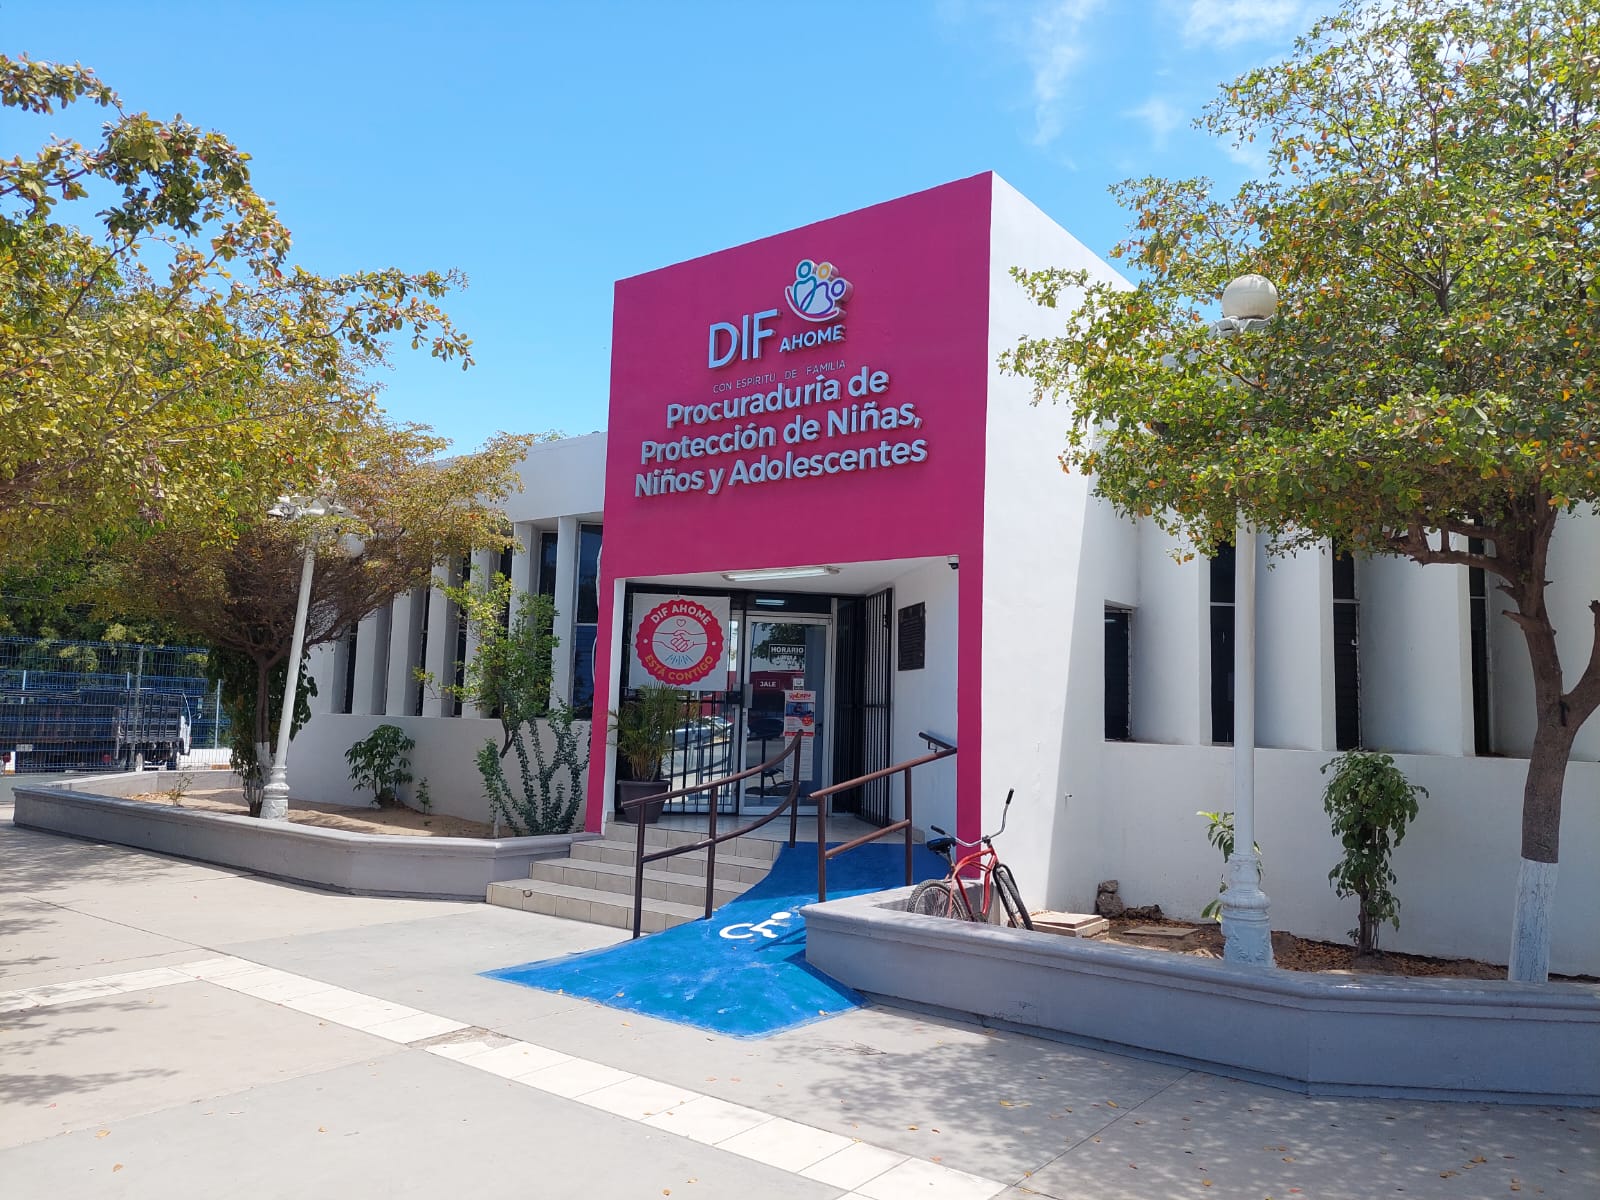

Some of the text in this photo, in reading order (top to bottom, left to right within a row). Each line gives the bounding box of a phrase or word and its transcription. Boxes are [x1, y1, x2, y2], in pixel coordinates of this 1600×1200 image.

[708, 308, 846, 369] DIF AHOME
[667, 366, 890, 429] Procuraduría de
[713, 382, 732, 394] CON
[785, 369, 798, 380] DE
[806, 360, 846, 376] FAMILIA
[641, 401, 923, 465] Protección de Niñas,
[635, 439, 929, 498] Niños y Adolescentes
[650, 604, 712, 625] DIF AHOME
[668, 655, 714, 680] CONTIGO
[770, 646, 804, 654] HORARIO
